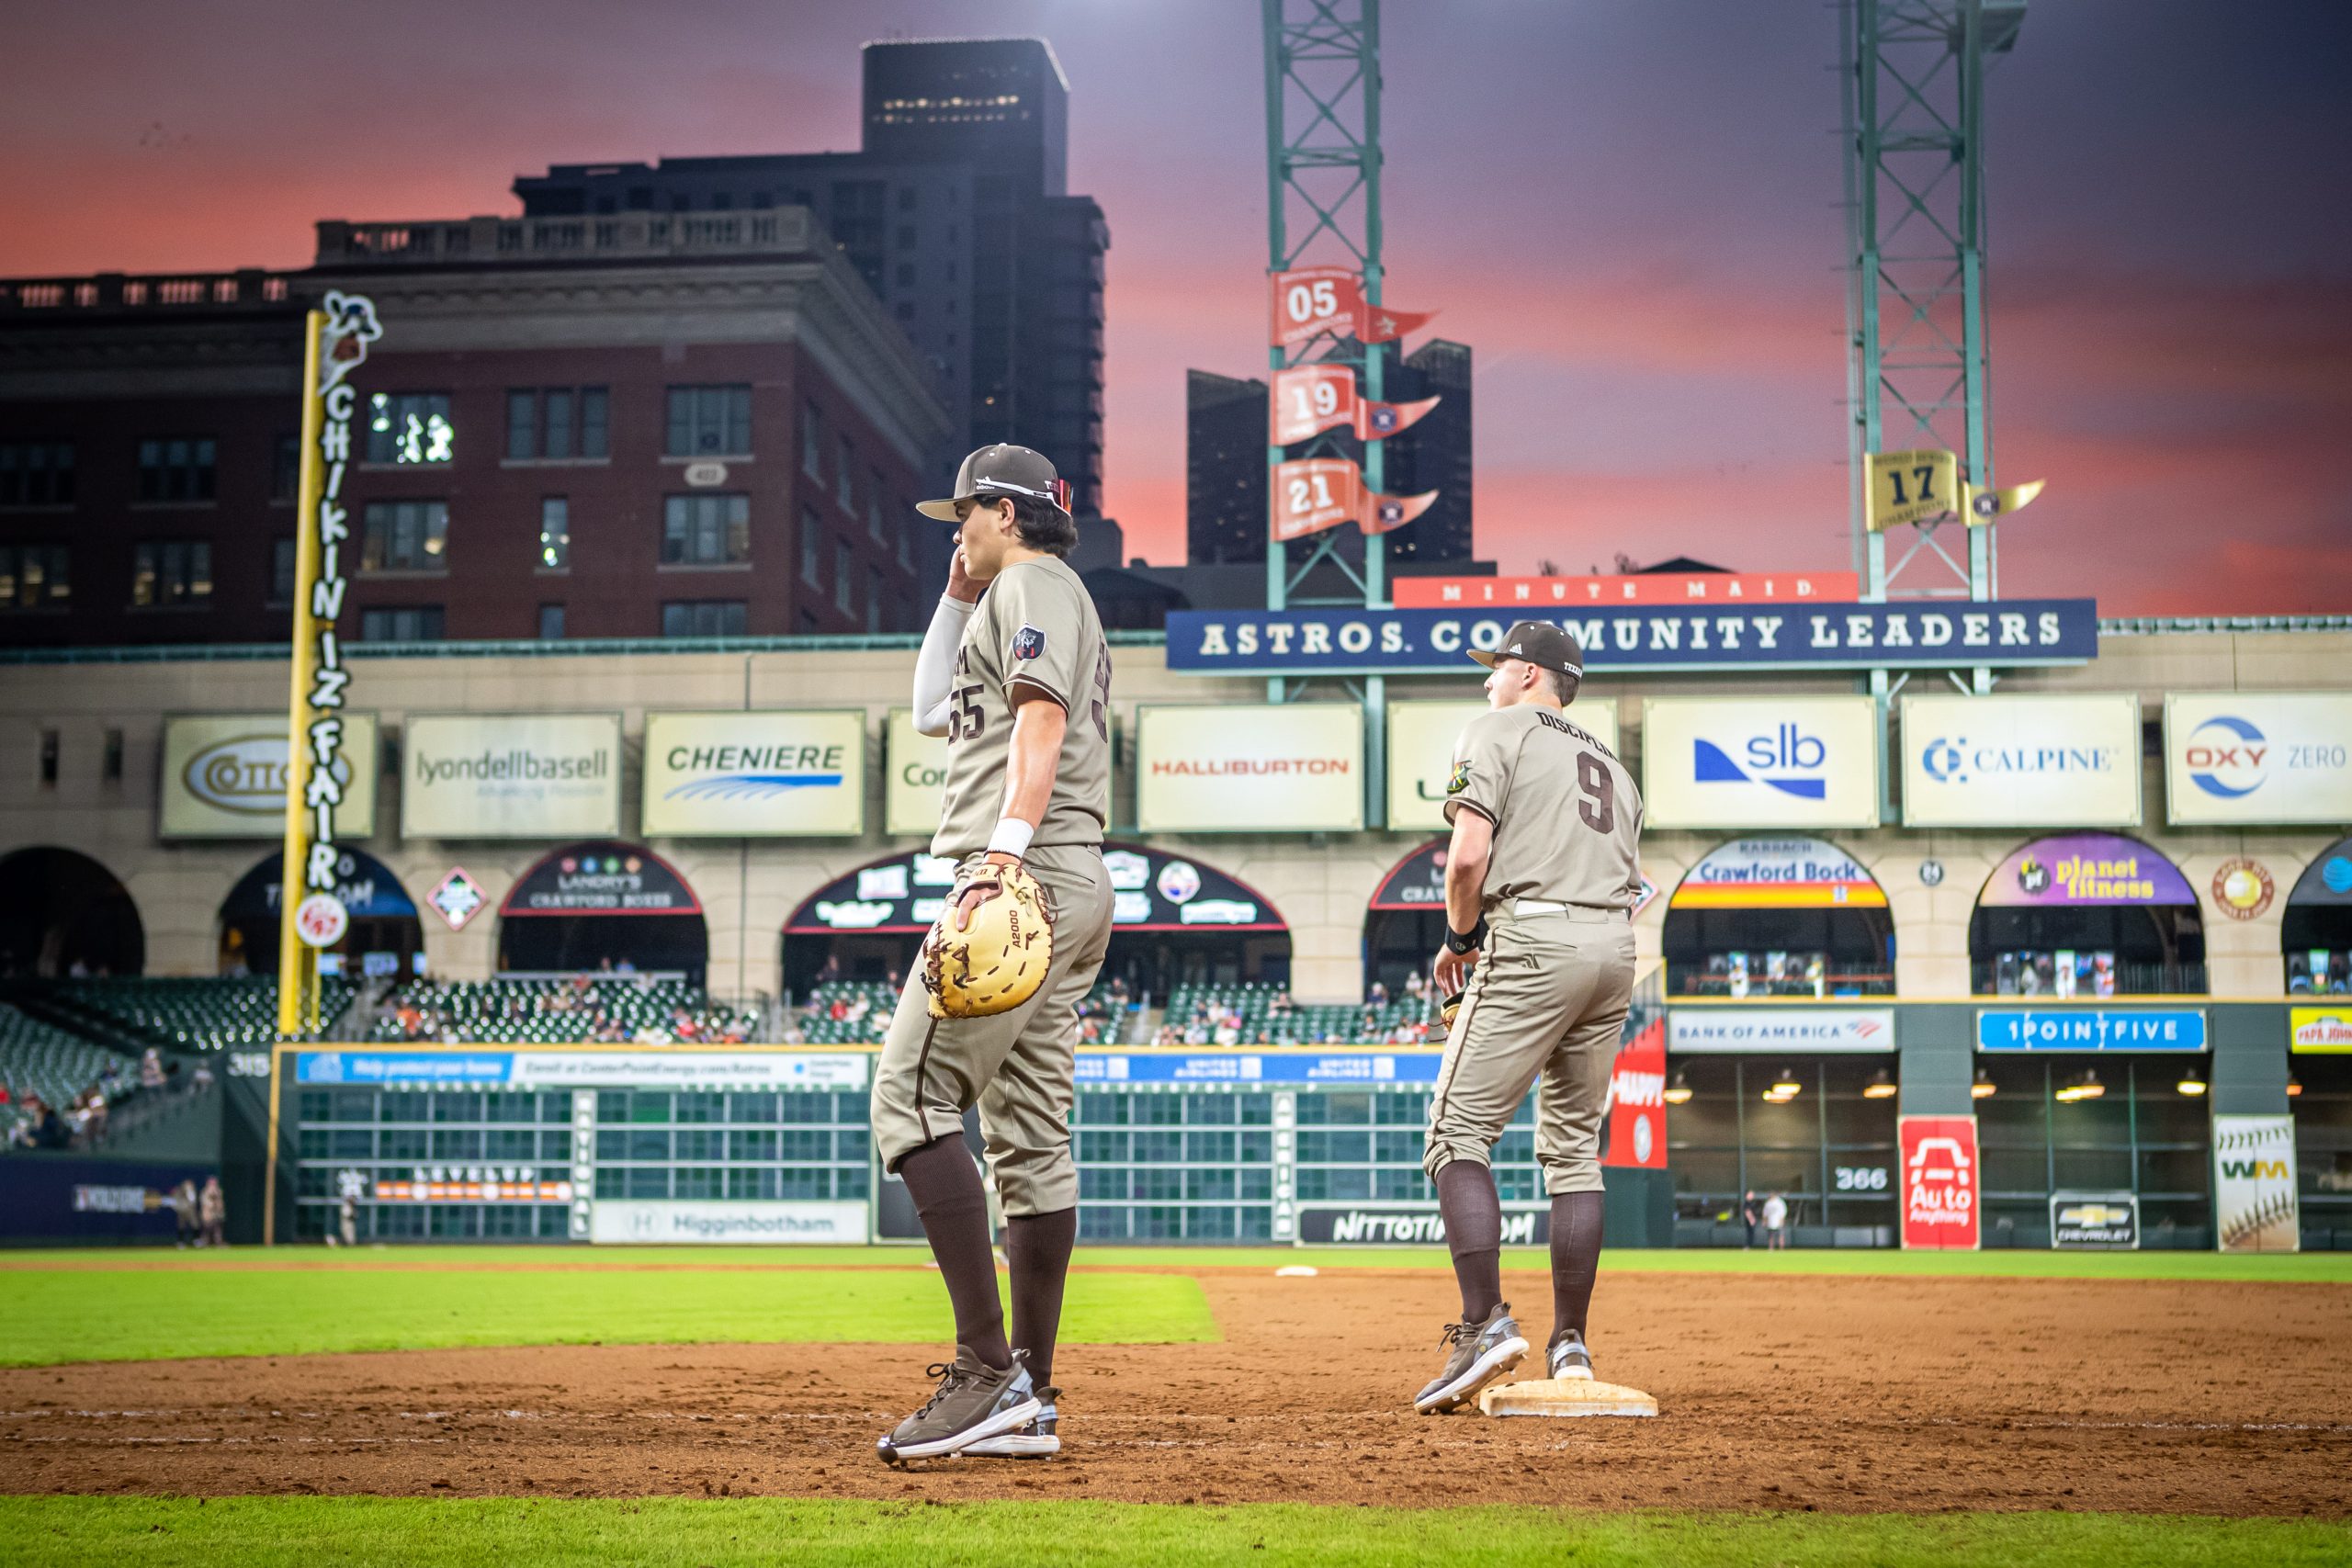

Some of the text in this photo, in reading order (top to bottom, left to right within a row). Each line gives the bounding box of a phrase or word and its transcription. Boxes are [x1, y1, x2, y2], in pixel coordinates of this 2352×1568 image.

[1288, 280, 1338, 323] 05
[1294, 381, 1338, 421] 19
[1289, 475, 1334, 514] 21
[1889, 466, 1935, 505] 17
[312, 383, 356, 621] CHIKIN
[1443, 582, 1636, 602] MINUTE
[1430, 616, 1783, 653] COMUNITY
[1811, 613, 2062, 649] LEADERS
[667, 745, 843, 771] CHENIERE
[1747, 723, 1825, 769] slb
[2186, 746, 2346, 769] OXY ZERO
[416, 749, 607, 788] lyondellbasell
[1152, 759, 1349, 776] HALLIBURTON
[1974, 749, 2111, 773] CALPINE
[1577, 750, 1614, 834] 9
[306, 719, 342, 891] FAIR
[1700, 861, 1858, 883] Crawford Bock
[2055, 854, 2139, 886] planet
[2066, 874, 2154, 899] fitness
[1009, 909, 1022, 949] A2000
[1679, 1024, 1841, 1040] BANK OF AMERICA
[227, 1053, 271, 1077] 315
[1186, 1057, 1238, 1068] UNITED
[1319, 1057, 1371, 1068] UNITED
[1835, 1167, 1888, 1190] 366
[2221, 1159, 2290, 1180] WM
[1909, 1184, 1972, 1210] Auto
[673, 1213, 835, 1235] Higginbotham
[1909, 1208, 1970, 1227] Anything
[2057, 1228, 2132, 1243] CHEVROLET
